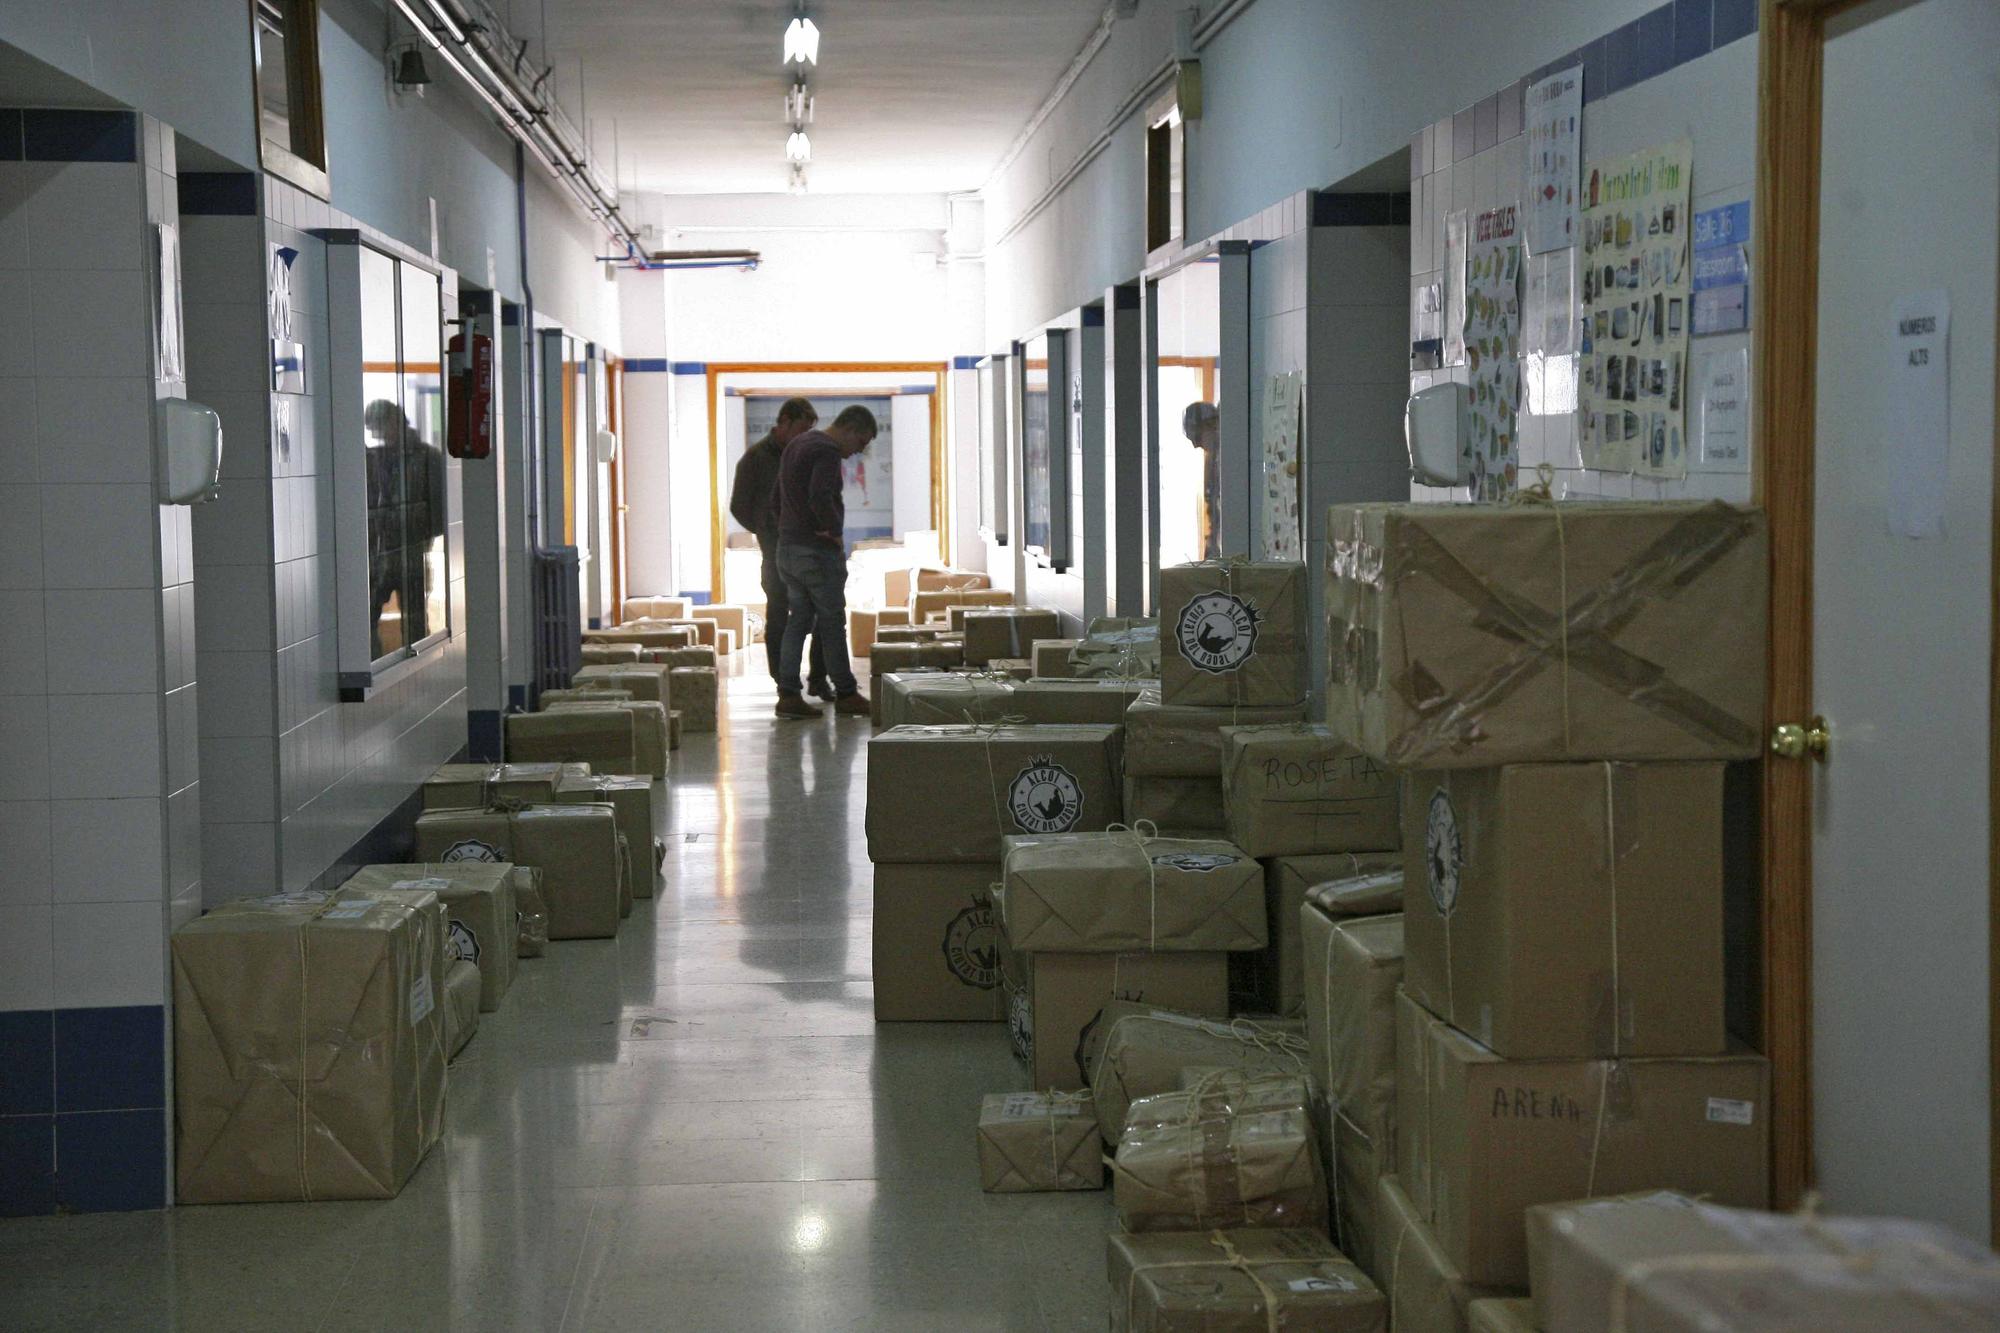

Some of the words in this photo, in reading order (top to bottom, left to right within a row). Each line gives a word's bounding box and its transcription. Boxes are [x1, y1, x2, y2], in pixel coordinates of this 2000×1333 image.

[1908, 348, 1929, 366] ALTS
[1226, 603, 1251, 637] ALCOI
[1027, 769, 1061, 787] ALCOI
[1262, 755, 1385, 792] ROSETA
[966, 911, 994, 929] ALC
